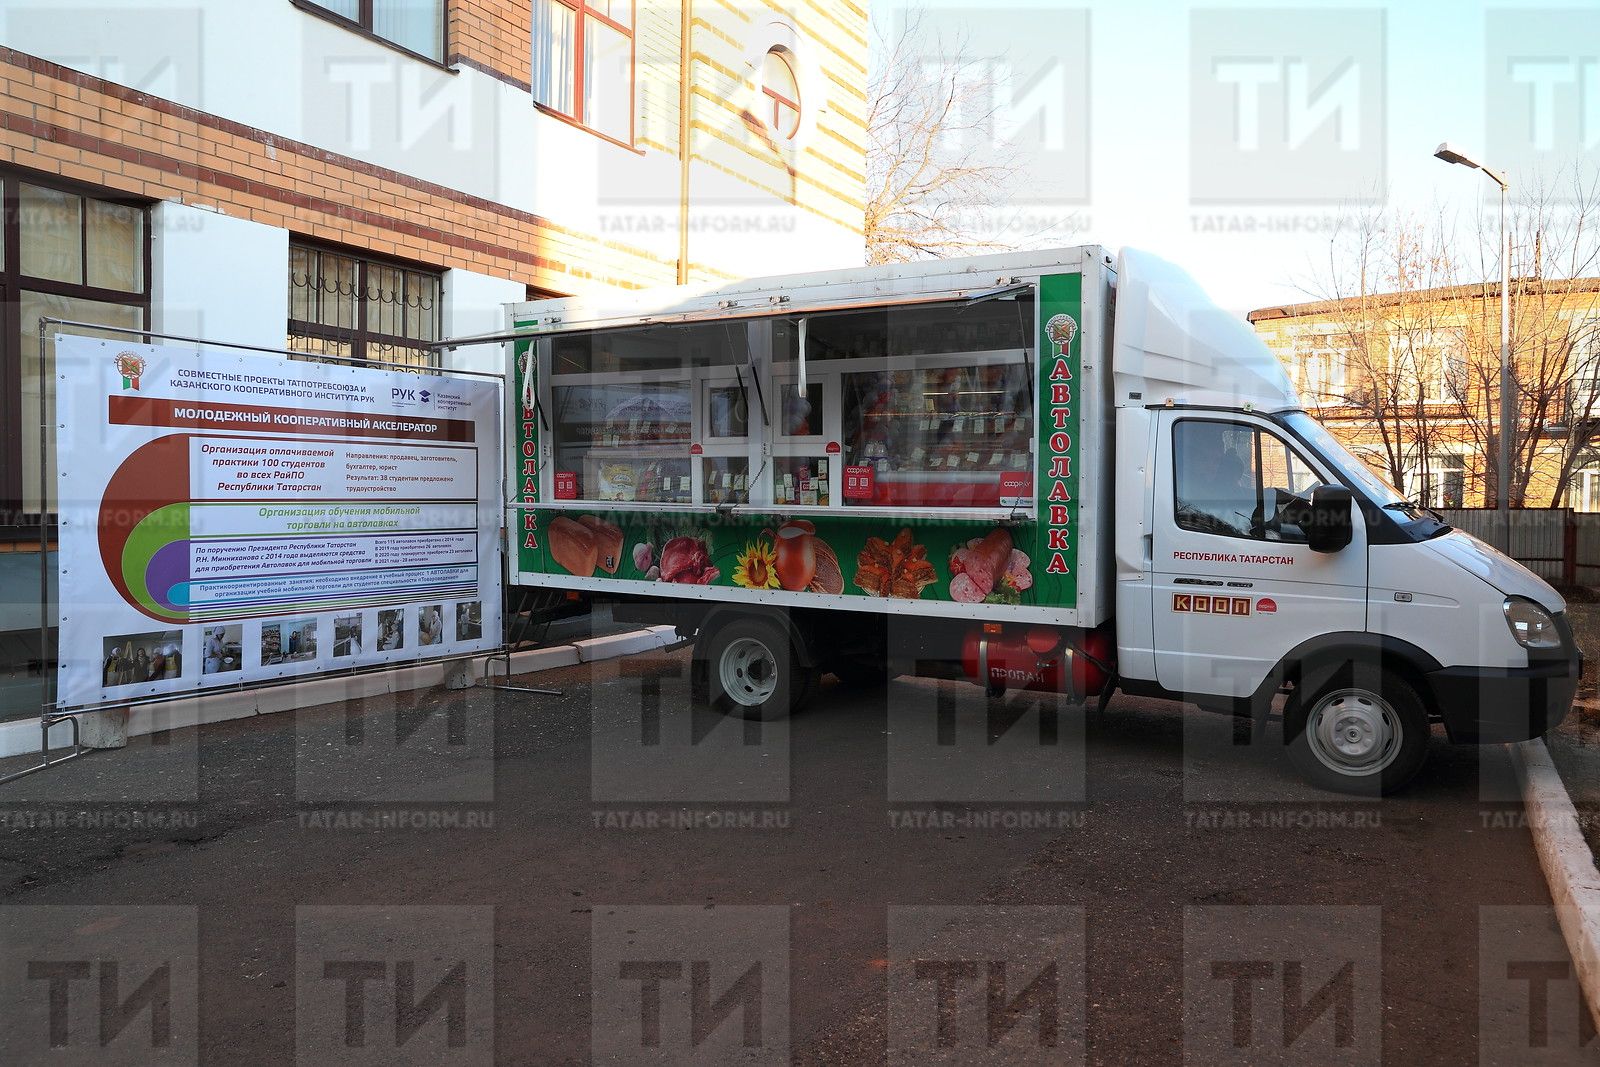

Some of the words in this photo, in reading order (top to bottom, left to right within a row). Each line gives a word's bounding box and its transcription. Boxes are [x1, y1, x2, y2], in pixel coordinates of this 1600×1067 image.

[178, 369, 242, 382] СОВМЕСТНЫЕ
[244, 375, 285, 386] ПРОЕКТЫ
[287, 379, 359, 392] ТАТПОТРЕБСОЮЗА
[170, 380, 231, 392] КАЗАНСКОГО
[234, 384, 313, 399] КООПЕРАТИВНОГО
[315, 392, 359, 403] ИНСТИТУТА
[392, 388, 416, 400] РУК
[174, 408, 271, 423] МОЛОДЕЖНЫЙ
[274, 414, 371, 429] КООПЕРАТИВНЫЙ
[372, 421, 438, 433] АКСЕЛЕРАТОР
[202, 444, 266, 456] Организация
[270, 448, 334, 457] оплачиваемой
[346, 452, 389, 460] Направления:
[212, 459, 259, 467] практики
[262, 459, 279, 467] 100
[281, 460, 325, 469] студентов
[1047, 359, 1072, 574] АВТОЛАВКА
[274, 471, 305, 479] РайПО
[218, 482, 274, 492] Республики
[276, 482, 322, 492] Татарстан
[259, 508, 326, 518] Организация
[328, 507, 371, 516] обучения
[373, 506, 420, 515] мобильной
[287, 522, 331, 531] торговли
[347, 520, 399, 528] автолавках
[207, 547, 246, 555] поручению
[248, 545, 287, 553] Президента
[1174, 552, 1237, 562] РЕСПУБЛИКА
[1240, 555, 1294, 565] ТАТАРСТАН
[211, 564, 260, 572] приобретения
[1174, 596, 1250, 614] КООП
